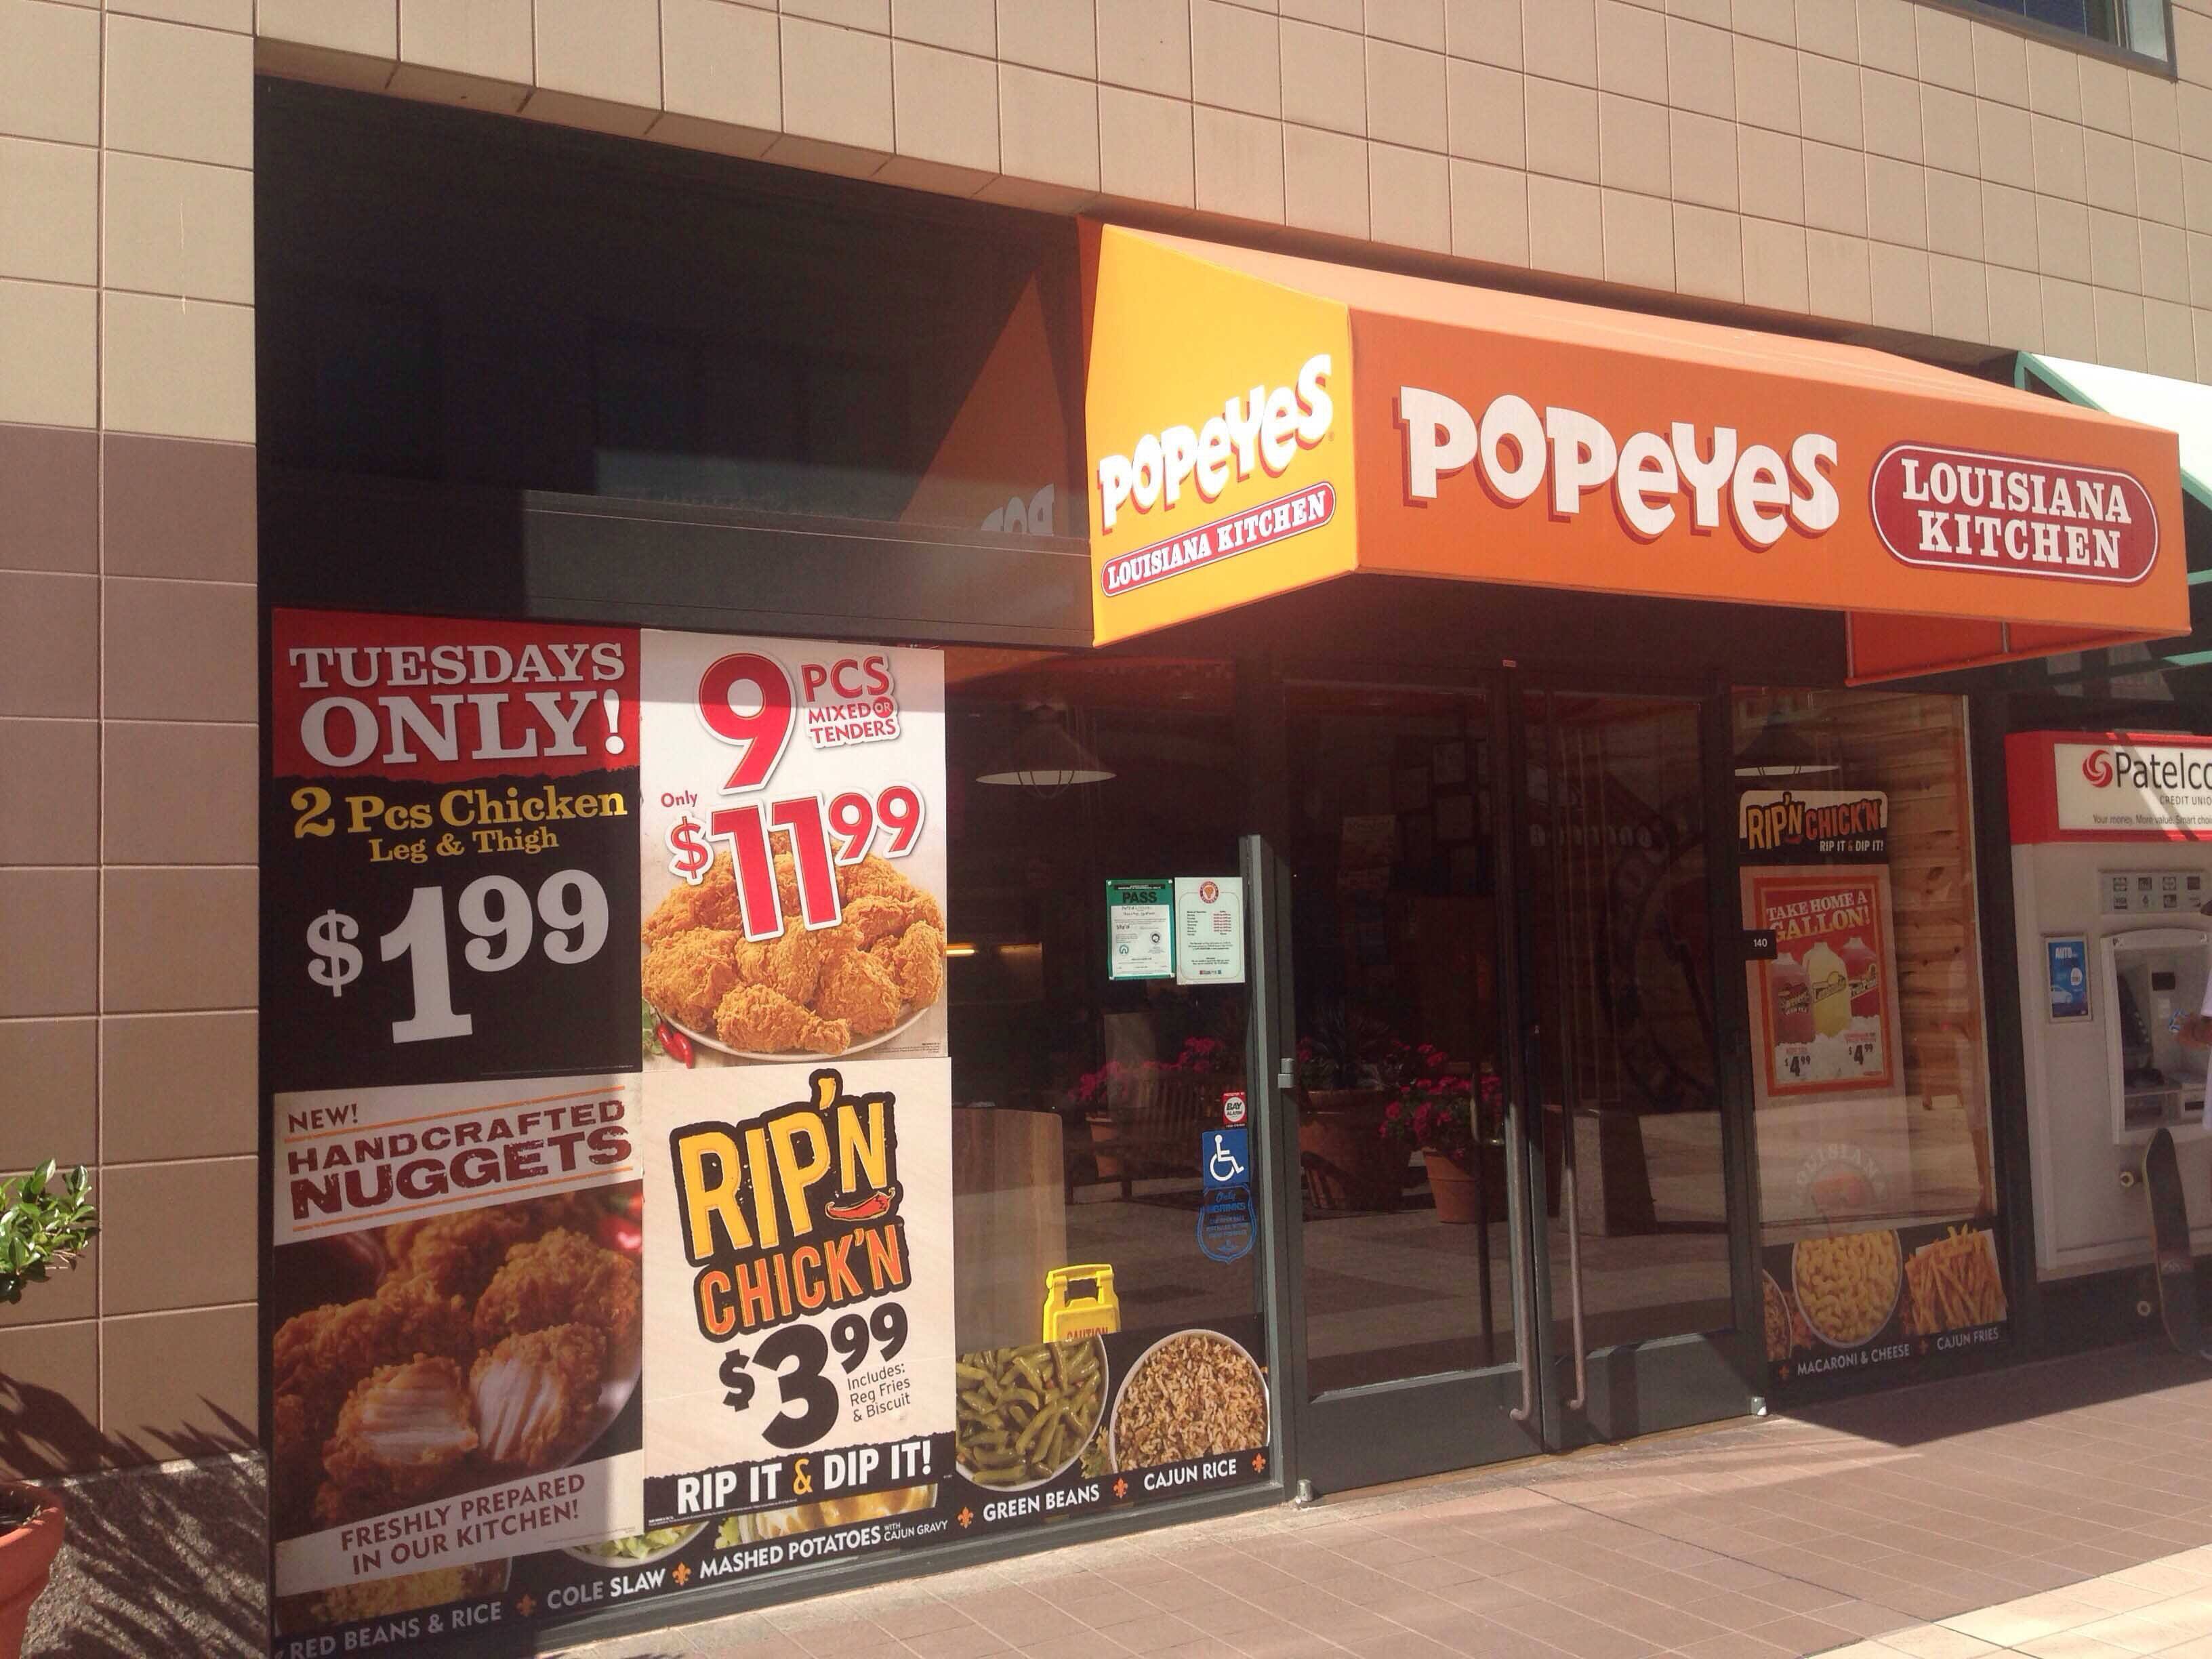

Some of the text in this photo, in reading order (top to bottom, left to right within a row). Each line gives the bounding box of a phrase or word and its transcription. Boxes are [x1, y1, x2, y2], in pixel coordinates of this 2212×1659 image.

[1901, 458, 2131, 524] LOUISIANA
[1107, 491, 1326, 590] LOUISIANA KITCHEN
[1918, 510, 2121, 569] KITCHEN
[289, 642, 625, 688] TUESDAYS
[300, 689, 624, 767] ONLY!
[699, 653, 890, 789] 9 PCS
[808, 702, 891, 724] MIXED OR
[811, 719, 896, 744] TENDERS
[291, 785, 628, 838] 2 Pcs Chicken
[661, 790, 697, 808] Only
[2160, 796, 2188, 804] CREDIT
[1746, 793, 1881, 850] RIP'N CHICK'N
[2093, 815, 2108, 824] Your
[2136, 815, 2154, 824] More
[2175, 815, 2196, 824] Smart
[369, 827, 558, 863] Leg & Thigh
[1820, 841, 1834, 852] RIP
[1837, 840, 1845, 851] IT
[1856, 840, 1869, 851] DIP
[1872, 840, 1883, 851] IT!
[1123, 891, 1158, 903] PASS
[1767, 890, 1867, 921] TAKE HOME A
[1769, 905, 1870, 942] GALLON!
[1753, 939, 1767, 947] 140
[289, 1103, 358, 1132] NEW!
[1227, 1102, 1242, 1110] BAY
[287, 1100, 625, 1174] HANDCRAFTED
[291, 1126, 632, 1220] NUGGETS
[678, 1077, 887, 1260] RIP'N
[700, 1225, 904, 1336] CHICK'N
[1937, 1327, 1999, 1350] CAJUN FRIES
[846, 1363, 905, 1391] Includes:
[1797, 1344, 1910, 1376] MACARONI & CHEESE
[850, 1377, 911, 1409] Reg Fries
[853, 1393, 911, 1422] & Biscuit
[678, 1471, 737, 1514] RIP
[750, 1462, 782, 1502] IT
[793, 1458, 813, 1495] &
[824, 1448, 879, 1490] DIP
[891, 1440, 931, 1479] IT!
[1144, 1459, 1237, 1491] CAJUN RICE
[341, 1473, 585, 1551] FRESHLY PREPARED
[983, 1484, 1100, 1521] GREEN BEANS
[353, 1549, 381, 1574] IN
[391, 1534, 447, 1564] OUR
[457, 1499, 579, 1549] KITCHEN!
[884, 1522, 901, 1531] WITH
[884, 1520, 948, 1541] CAJUN GRAVY
[699, 1525, 880, 1579] MASHED POTATOES
[548, 1568, 665, 1609] COLE SLAW
[290, 1601, 501, 1659] RED BEANS & RICE
